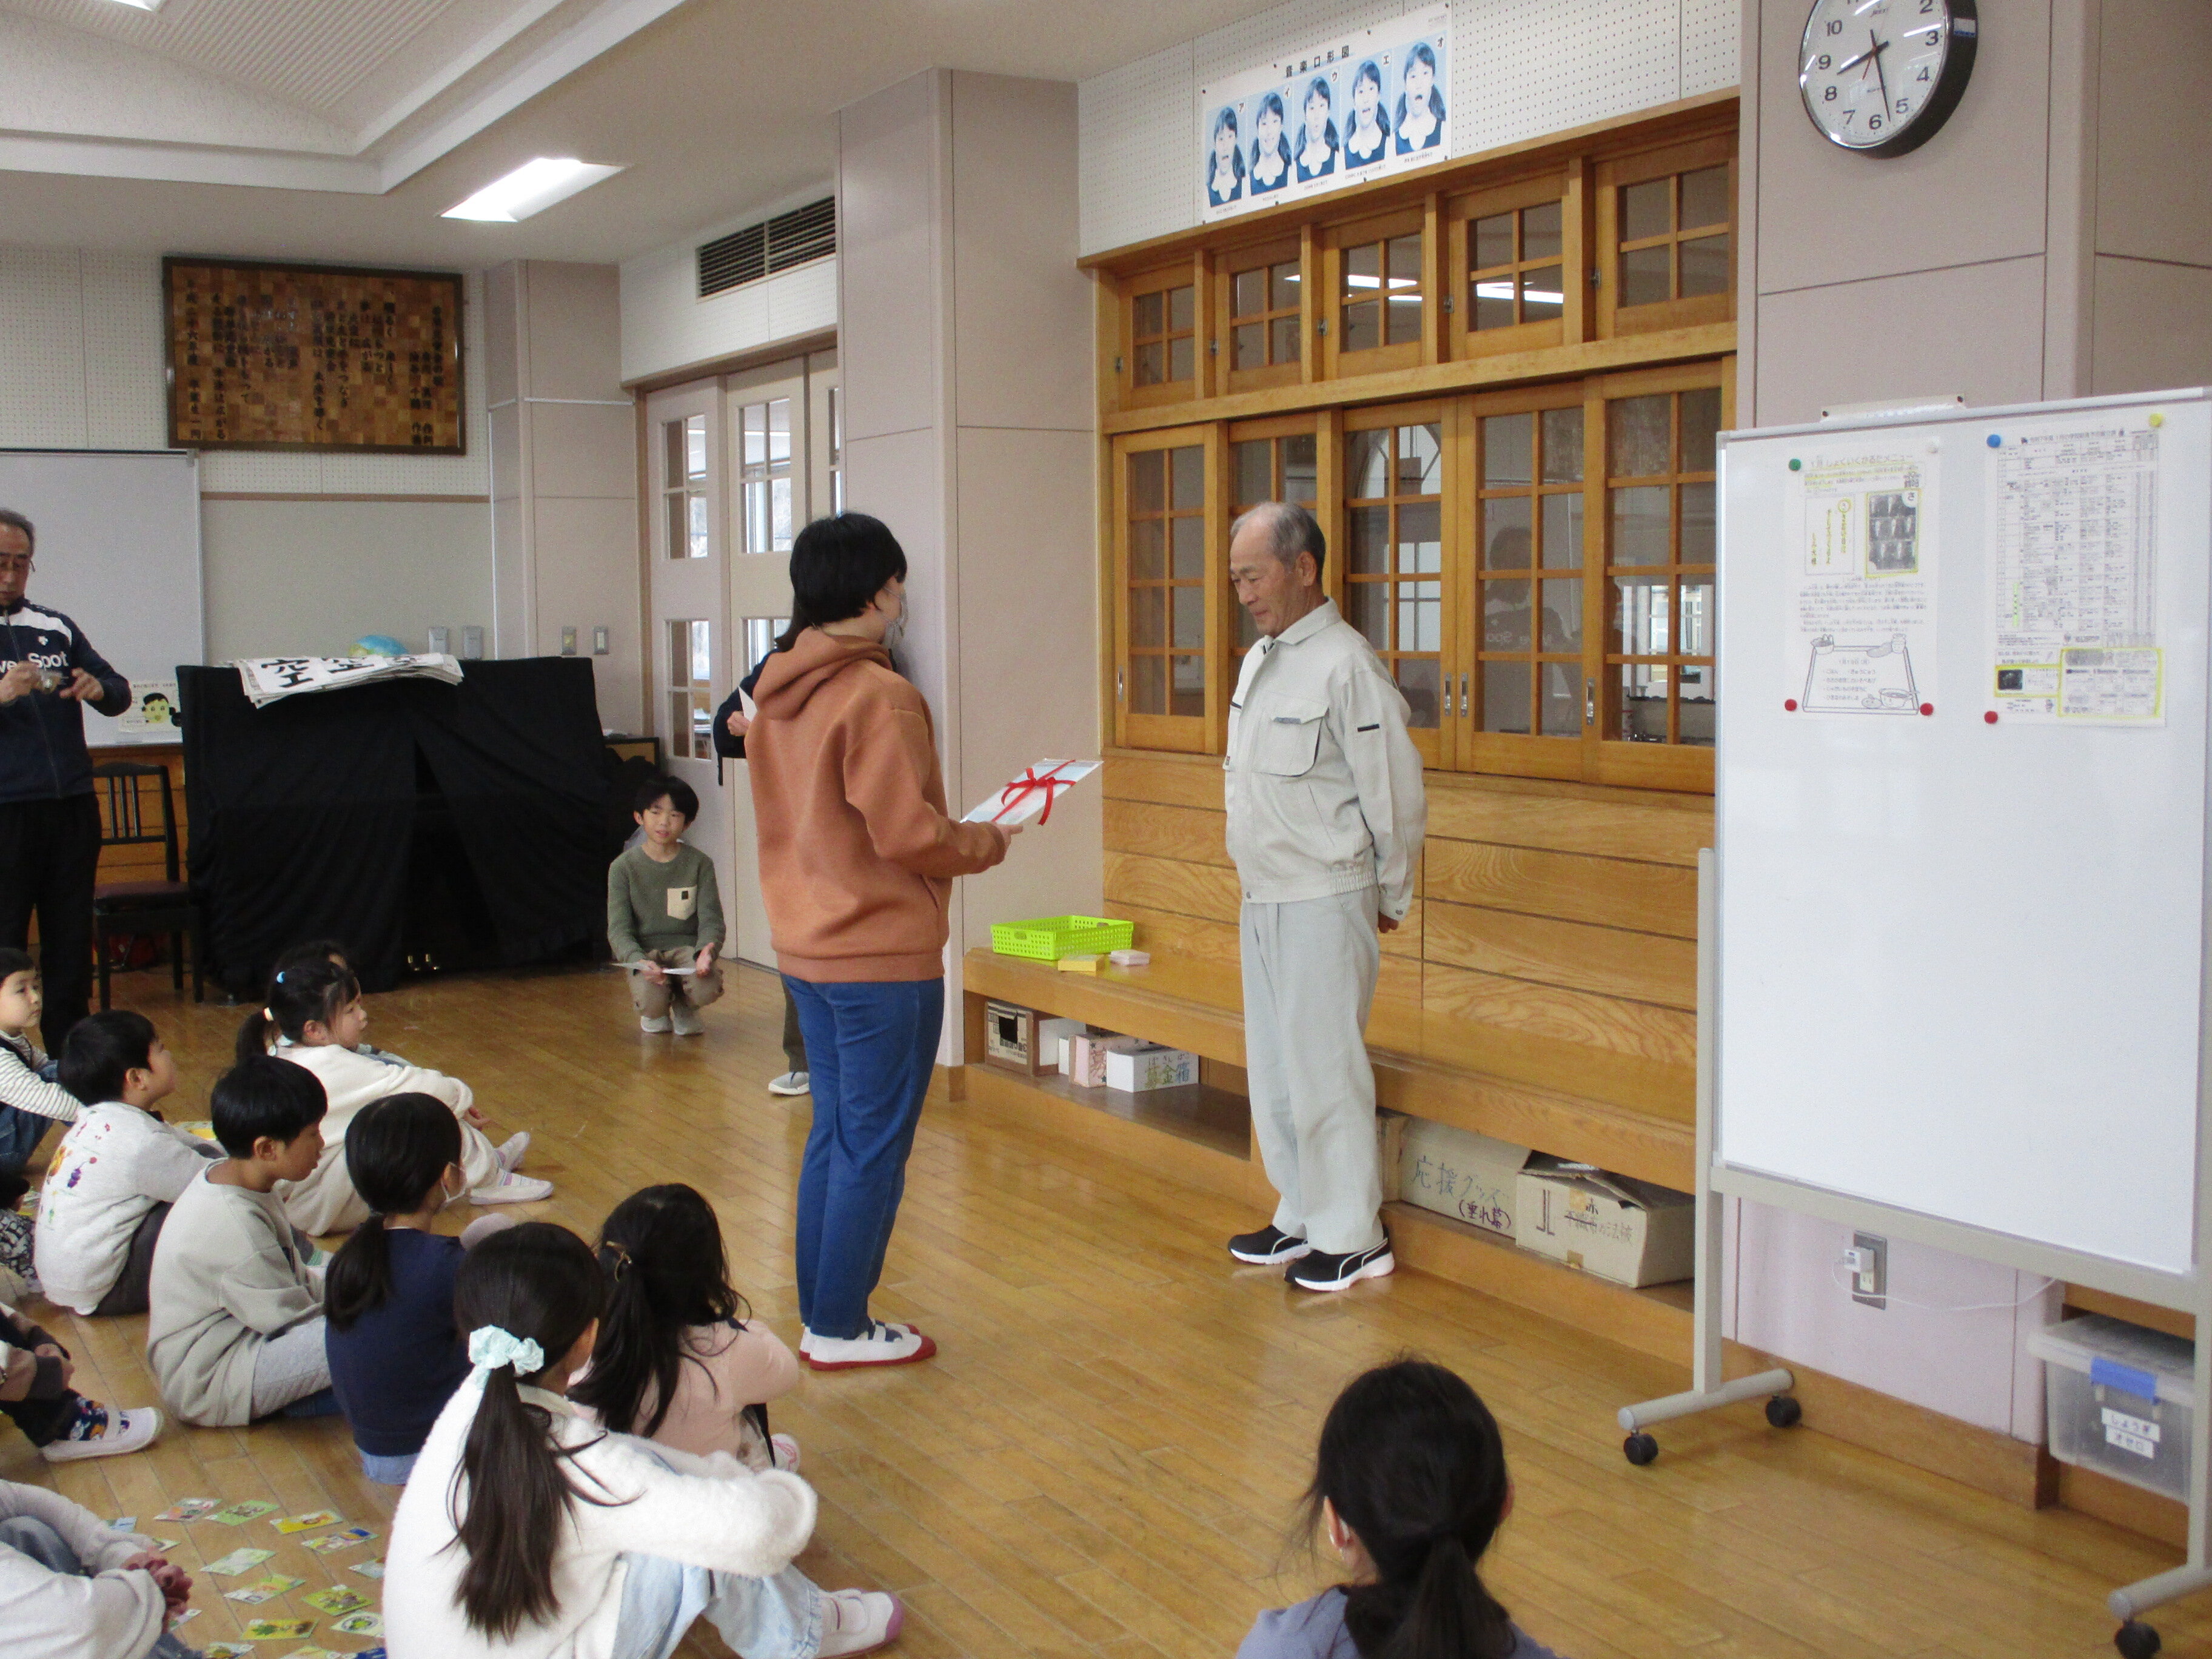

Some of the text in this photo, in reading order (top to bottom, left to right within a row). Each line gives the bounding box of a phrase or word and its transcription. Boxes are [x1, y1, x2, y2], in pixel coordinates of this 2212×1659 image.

[1920, 0, 1933, 13] 2
[1826, 19, 1842, 36] 10
[1926, 30, 1939, 46] 3
[1285, 45, 1349, 78] 音楽口形図
[1818, 55, 1832, 70] 9
[1332, 72, 1338, 81] ウ
[1917, 67, 1929, 82] 4
[1825, 85, 1837, 101] 8
[1896, 98, 1909, 114] 5
[1843, 109, 1855, 125] 7
[1869, 115, 1882, 130] 6
[261, 659, 315, 688] 空
[1410, 1155, 1509, 1207] 応援グッズ
